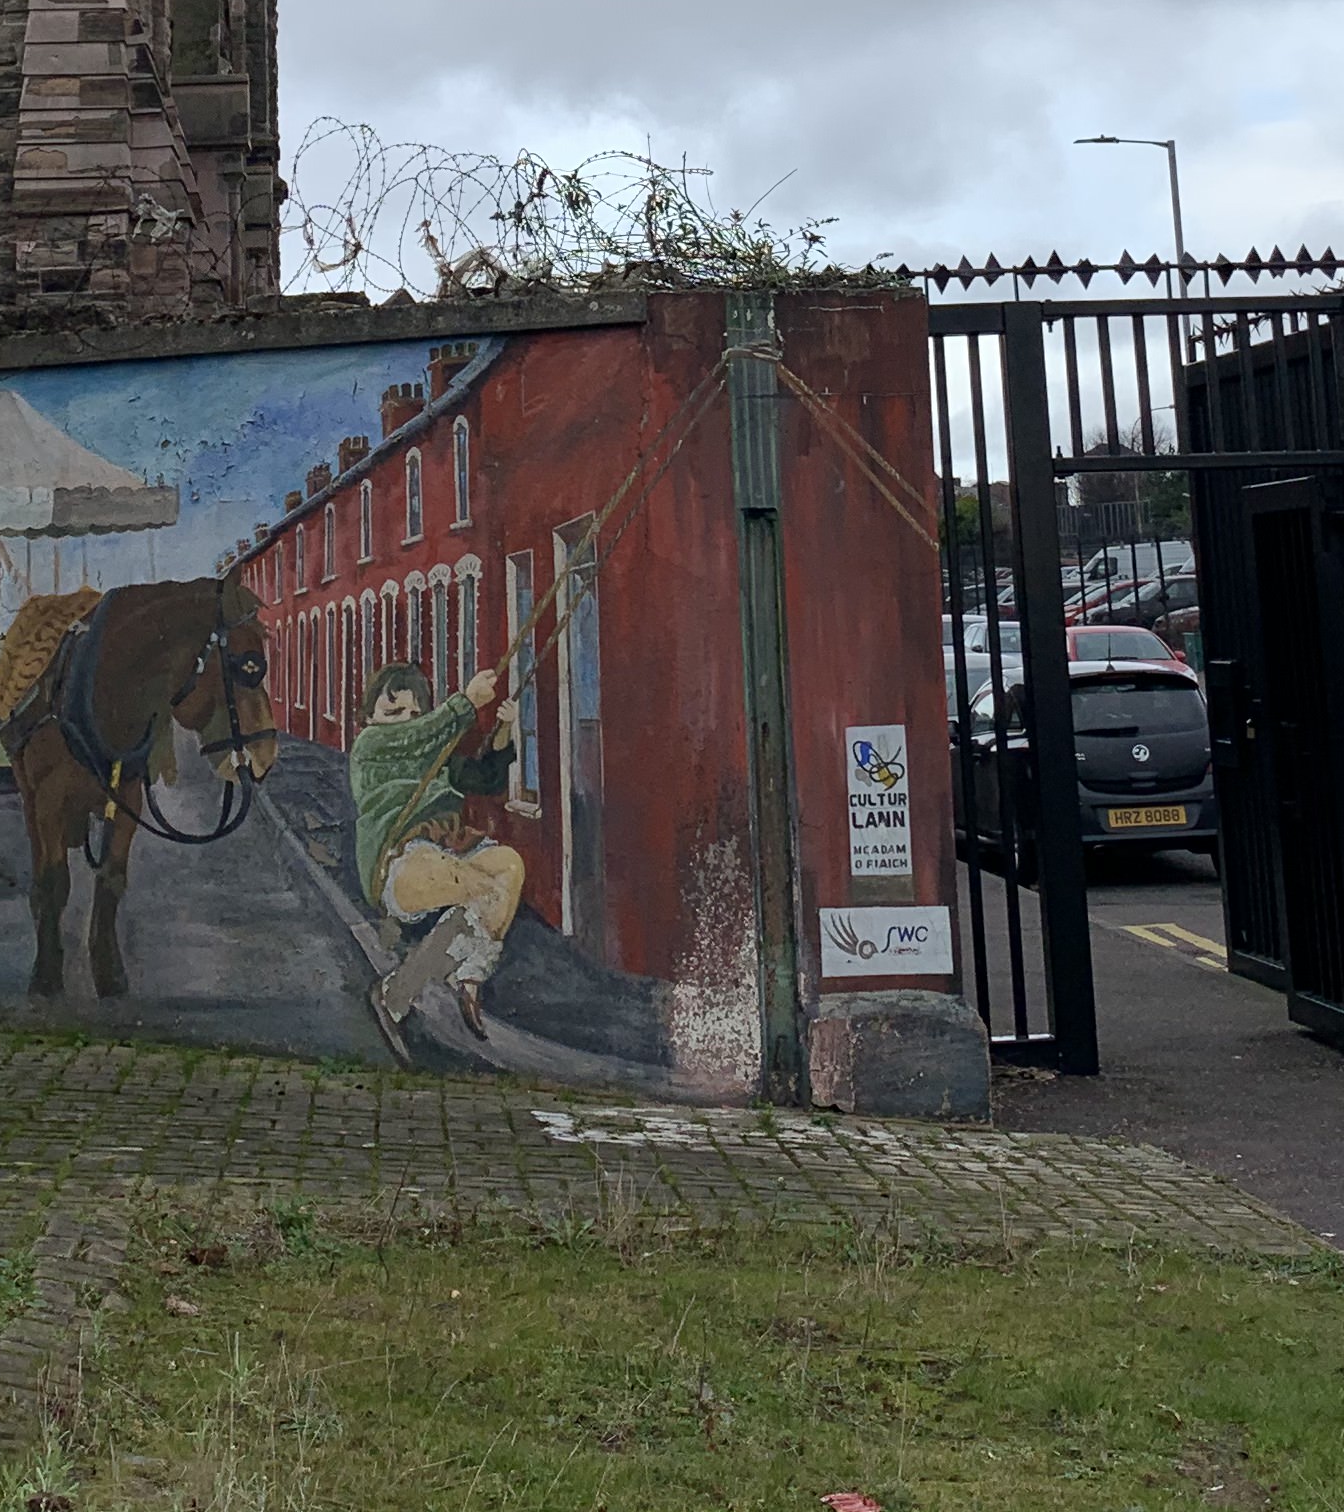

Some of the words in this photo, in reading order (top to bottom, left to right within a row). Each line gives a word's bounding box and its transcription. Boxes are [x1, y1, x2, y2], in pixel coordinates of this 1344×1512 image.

[849, 793, 907, 807] CULTUR
[852, 811, 905, 828] LANN
[1114, 810, 1141, 825] HRZ
[853, 844, 907, 855] MCADAM
[866, 858, 908, 869] FIAICH
[881, 926, 928, 953] SWC
